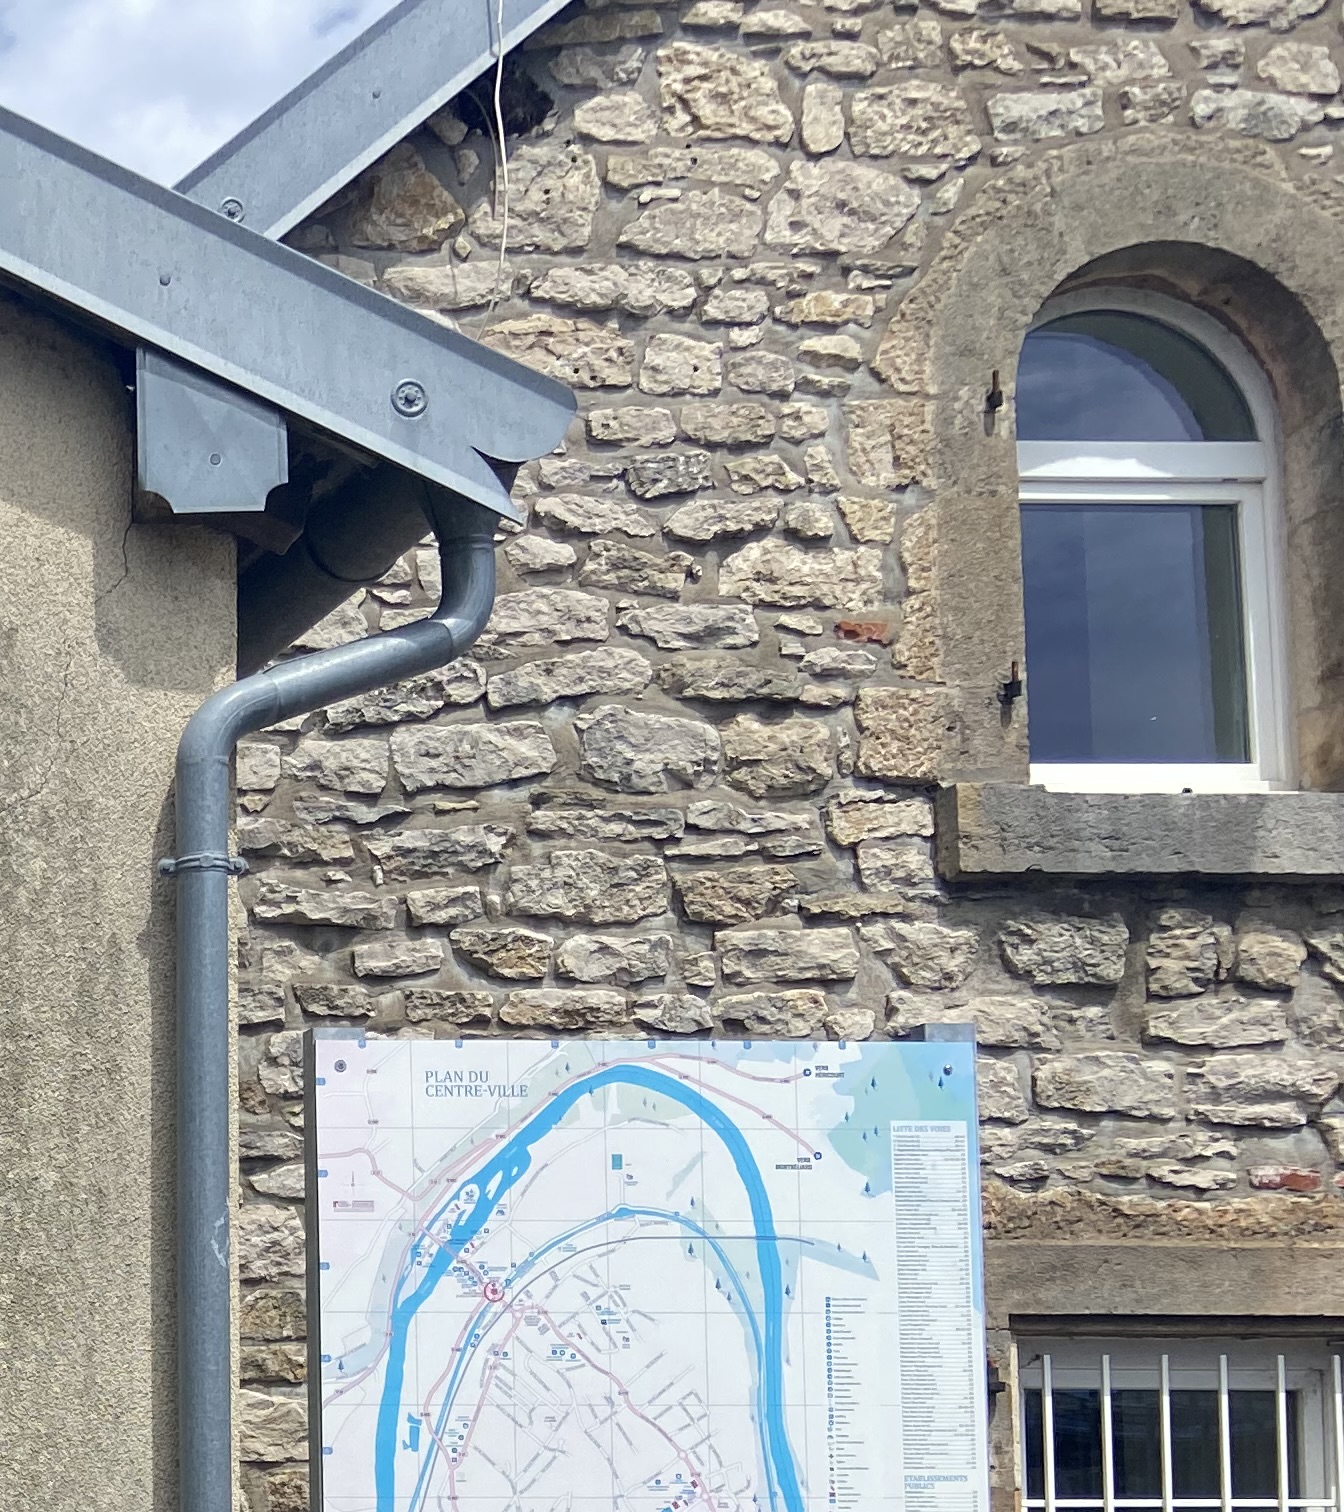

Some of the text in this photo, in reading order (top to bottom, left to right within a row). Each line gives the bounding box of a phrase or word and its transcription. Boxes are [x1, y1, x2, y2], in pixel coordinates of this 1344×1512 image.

[424, 1070, 489, 1083] PLAN DU
[425, 1084, 529, 1098] CENTRE-VILLE
